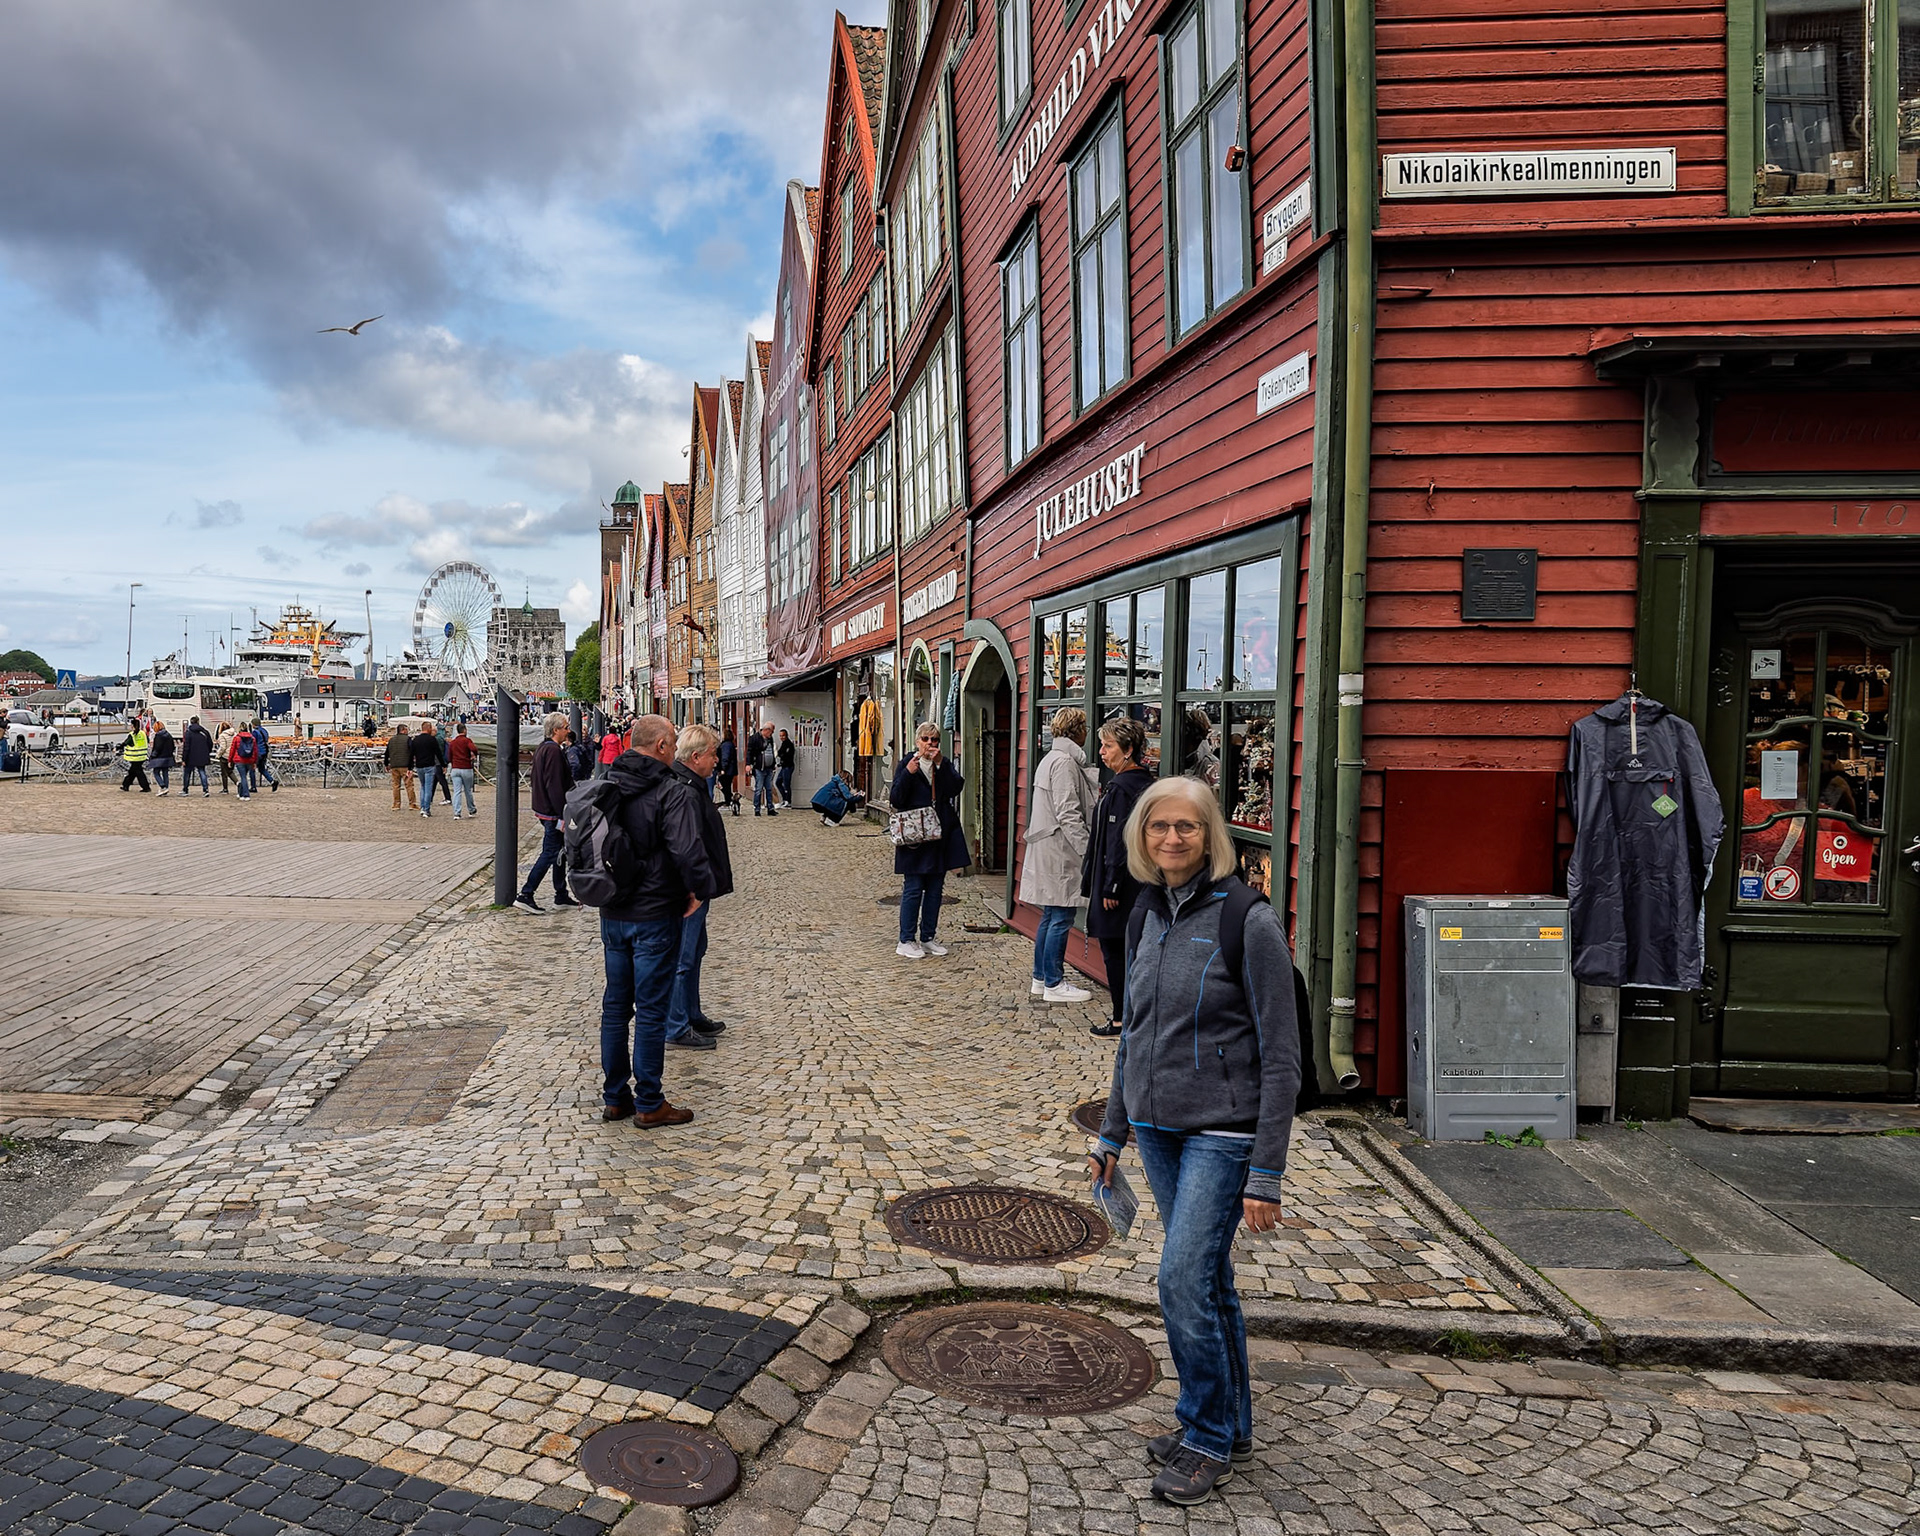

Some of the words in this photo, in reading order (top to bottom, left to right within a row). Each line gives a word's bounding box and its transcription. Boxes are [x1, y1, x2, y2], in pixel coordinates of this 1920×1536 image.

[1010, 47, 1087, 203] AUDHILD
[1088, 0, 1141, 69] VIK
[1399, 155, 1661, 185] Nikolaikirkeallmenningen
[1266, 194, 1303, 237] Bryggen
[1261, 366, 1305, 407] Tyskebryggen
[1033, 441, 1147, 560] JULEHUSET
[1822, 848, 1857, 869] Open
[1442, 1068, 1484, 1076] Kabeldon
